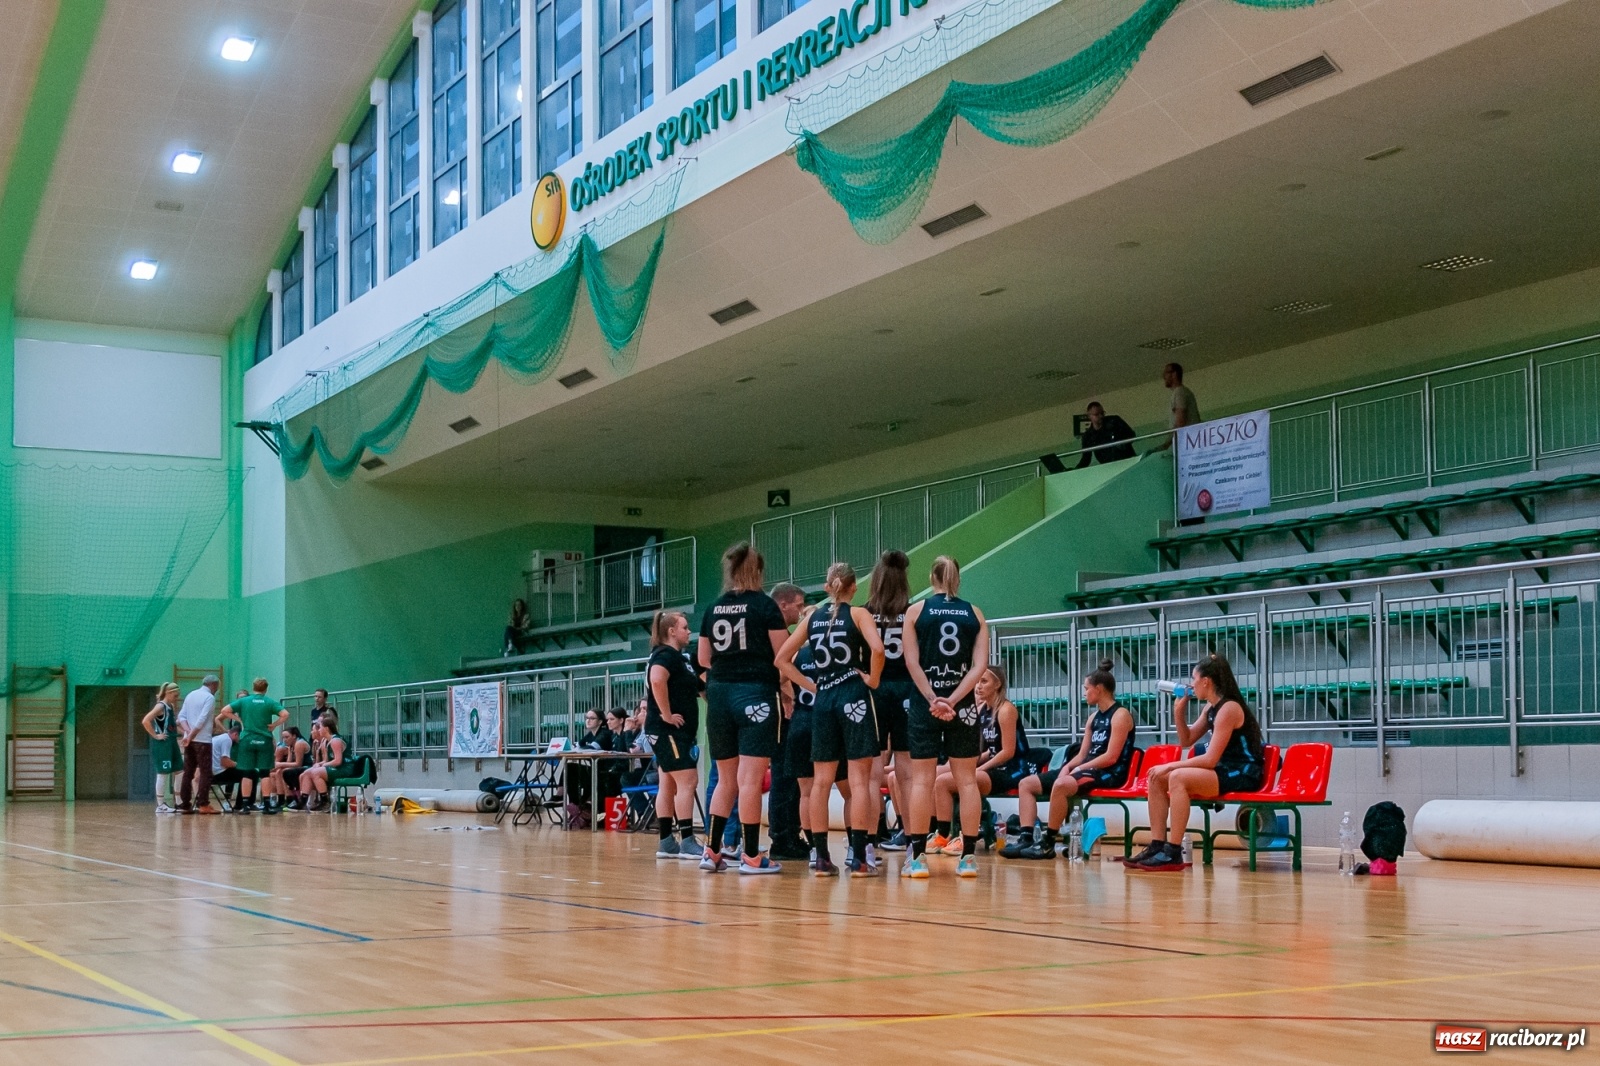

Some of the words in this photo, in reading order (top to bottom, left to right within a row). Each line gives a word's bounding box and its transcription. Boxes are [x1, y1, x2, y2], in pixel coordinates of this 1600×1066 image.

[570, 131, 653, 212] OŚRODEK
[656, 78, 738, 161] SPORTU
[743, 69, 752, 110] I
[757, 0, 892, 101] REKREACJI
[1185, 418, 1258, 451] MIESZKO
[771, 495, 786, 506] A
[713, 604, 748, 615] KRAWCZYK
[929, 608, 969, 617] Szymczak
[712, 618, 747, 652] 91
[810, 631, 852, 669] 35
[938, 621, 961, 656] 8
[609, 800, 624, 822] 5
